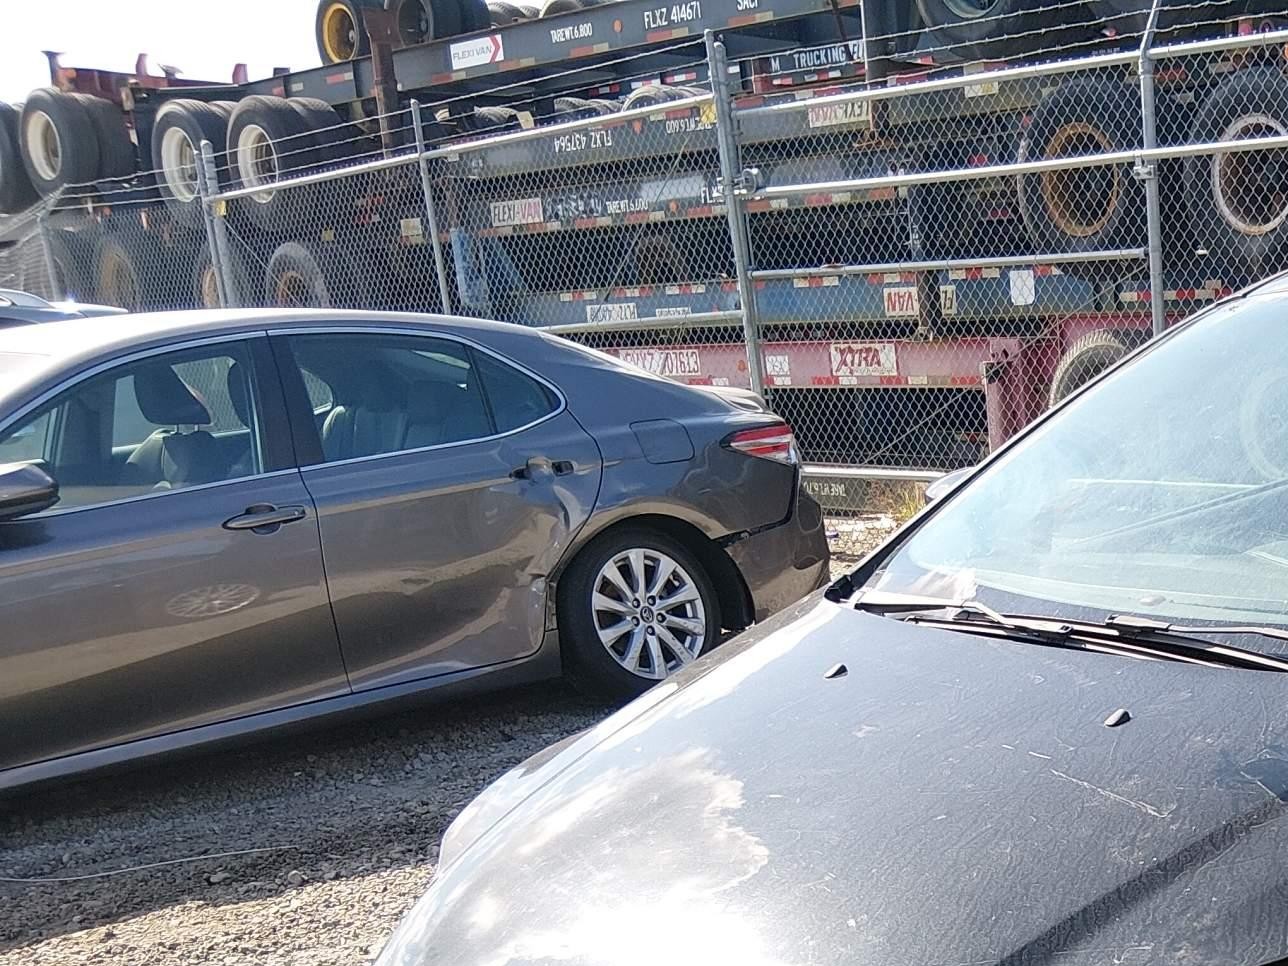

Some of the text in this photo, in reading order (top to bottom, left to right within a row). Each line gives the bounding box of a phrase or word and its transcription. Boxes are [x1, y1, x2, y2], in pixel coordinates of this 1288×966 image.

[644, 1, 702, 29] FLXZ 414671
[793, 46, 846, 68] TRUCKING
[554, 130, 612, 152] FLXZ 437564
[833, 346, 881, 373] XTRA
